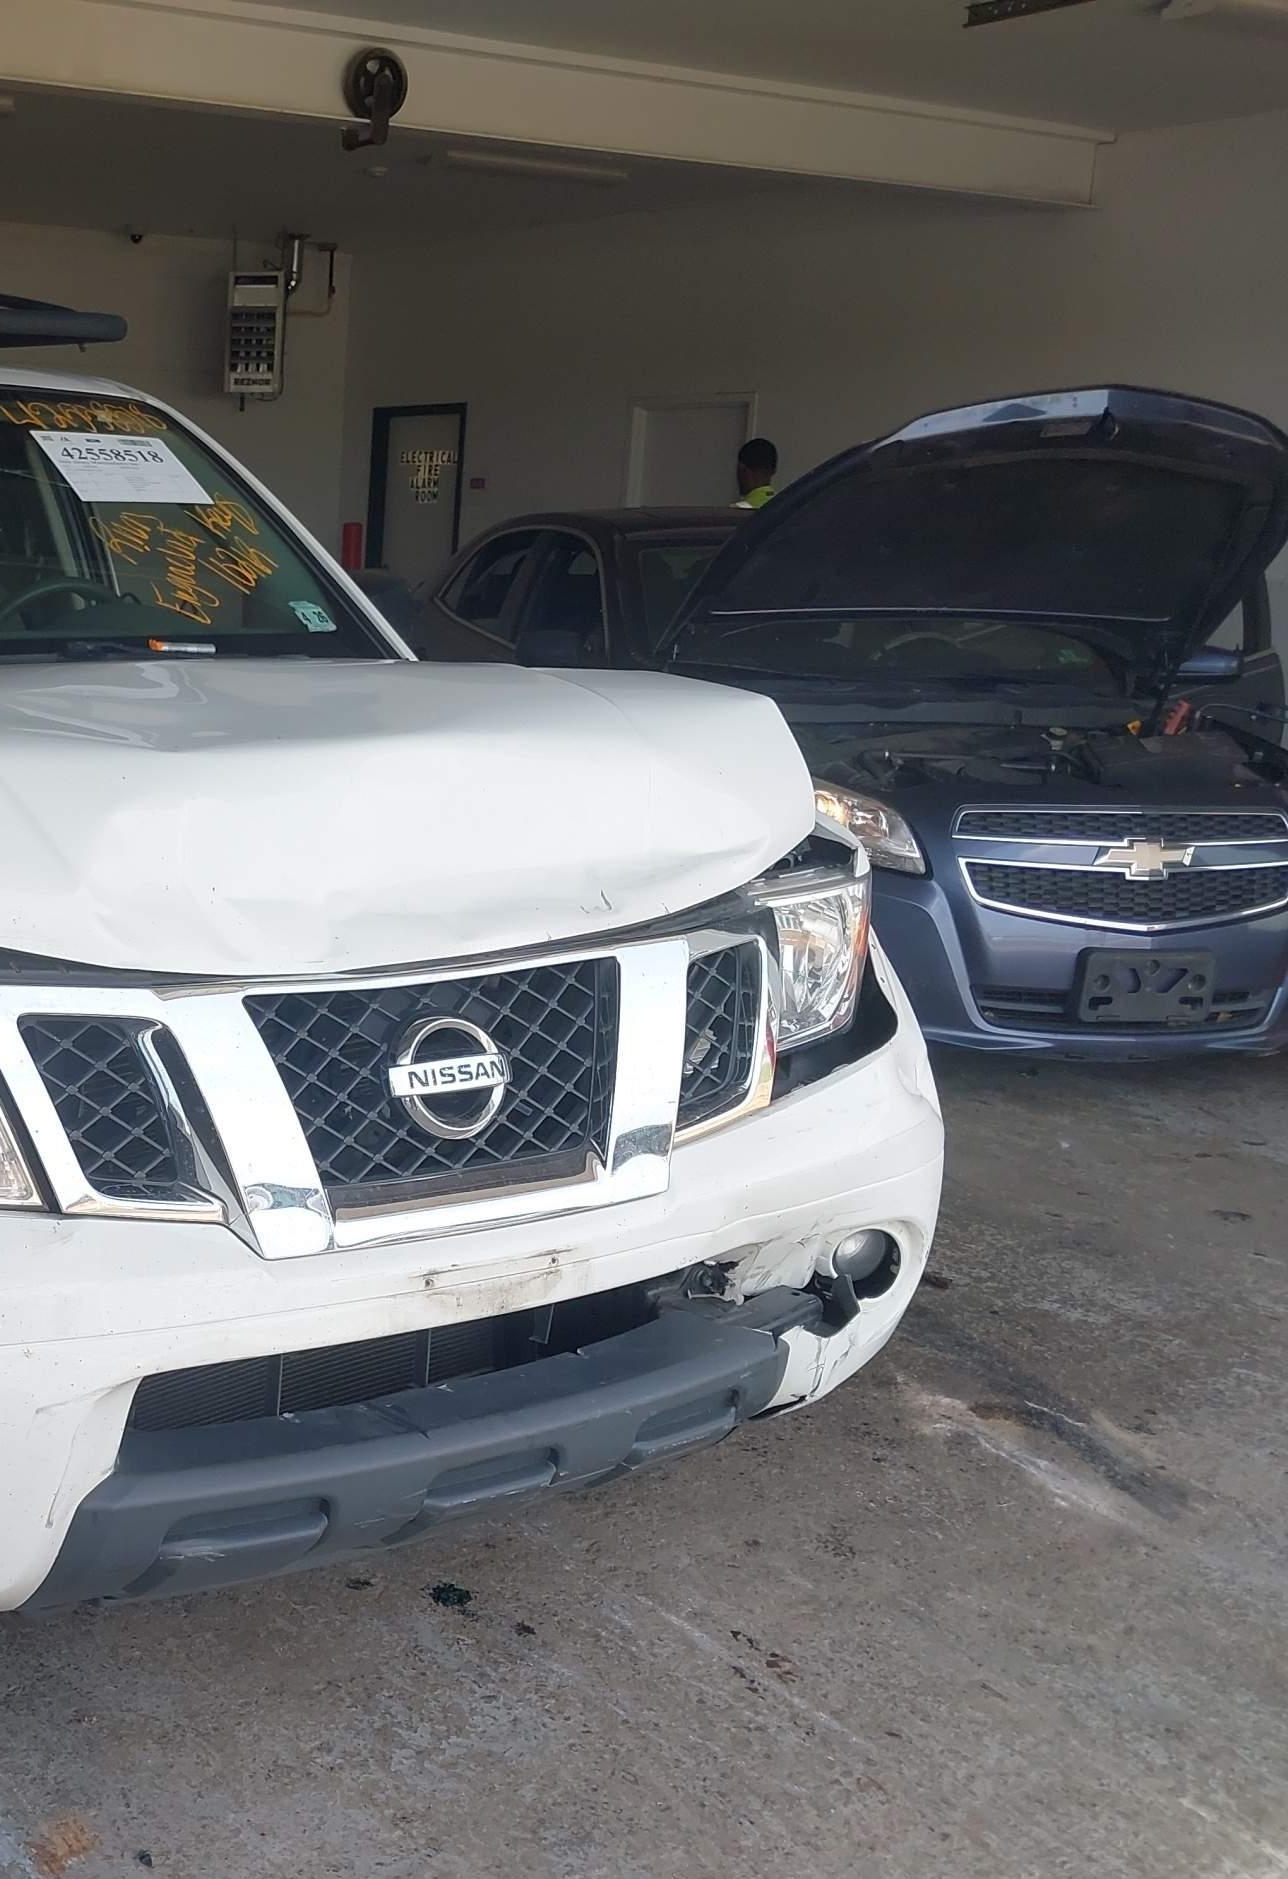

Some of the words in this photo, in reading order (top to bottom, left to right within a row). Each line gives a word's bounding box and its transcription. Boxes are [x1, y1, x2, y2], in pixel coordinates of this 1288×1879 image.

[61, 447, 164, 463] 42558518
[400, 450, 457, 464] ELECTRICAL
[416, 464, 440, 477] FIRE
[410, 477, 439, 489] ALARM
[415, 490, 439, 502] ROOM
[407, 1059, 506, 1089] NISSAN
